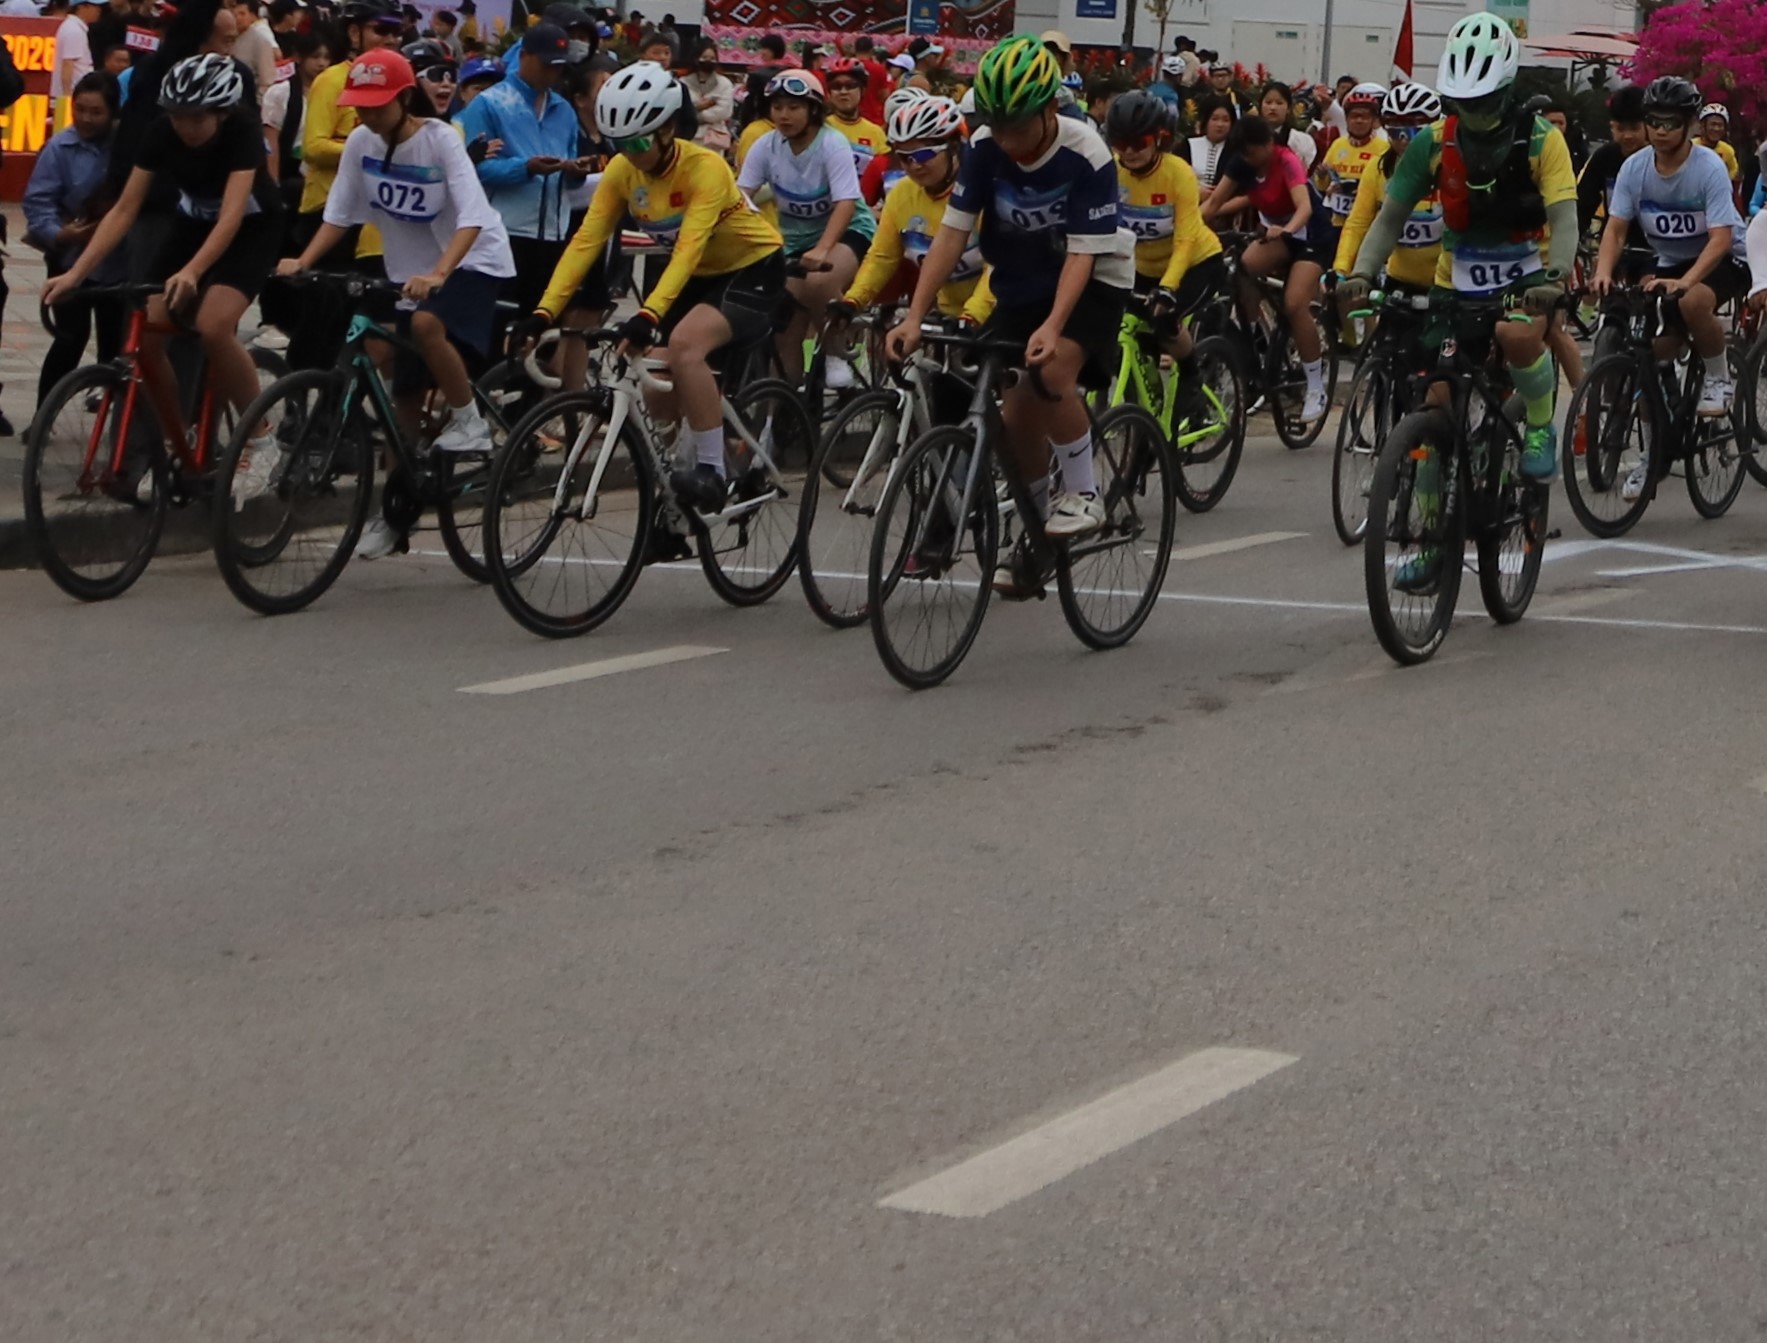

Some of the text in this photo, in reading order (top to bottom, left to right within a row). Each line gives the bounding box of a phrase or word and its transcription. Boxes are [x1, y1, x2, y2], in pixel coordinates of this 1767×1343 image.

[4, 34, 56, 71] 2026
[378, 181, 426, 212] 072
[789, 200, 828, 215] 070
[1655, 214, 1696, 234] 020
[1469, 262, 1524, 287] 016
